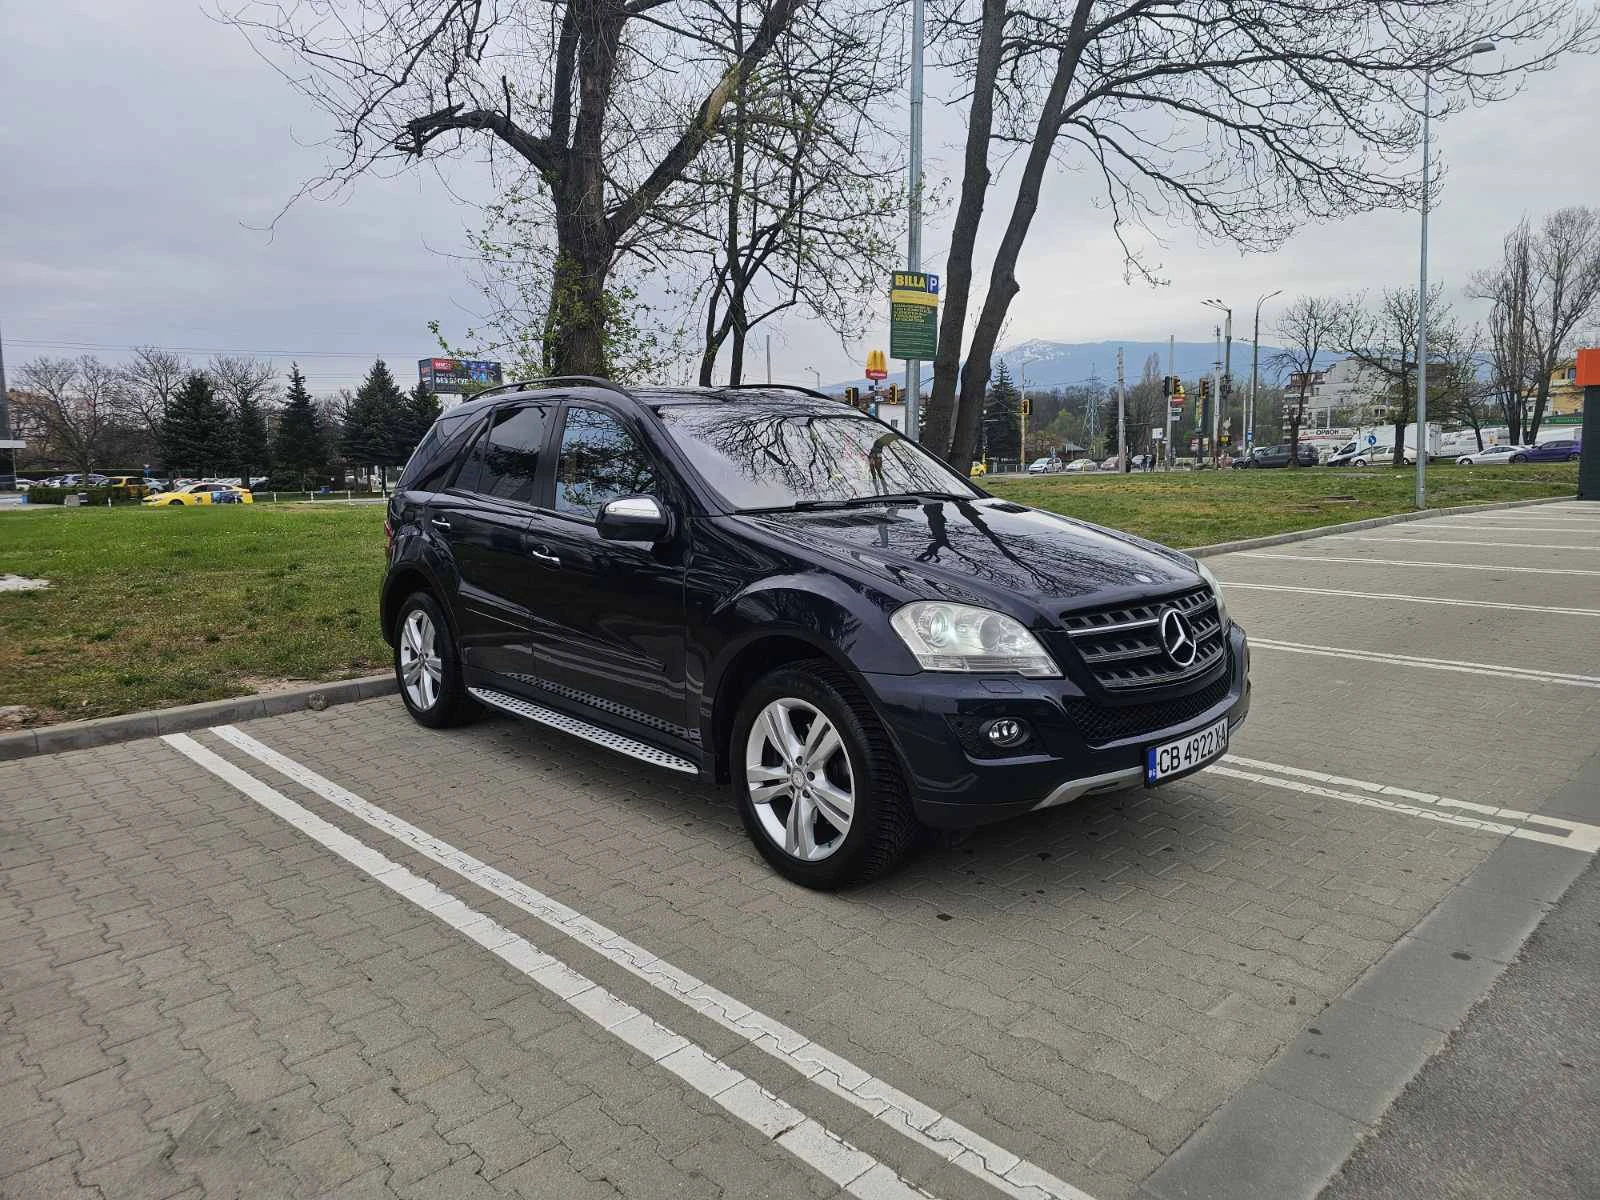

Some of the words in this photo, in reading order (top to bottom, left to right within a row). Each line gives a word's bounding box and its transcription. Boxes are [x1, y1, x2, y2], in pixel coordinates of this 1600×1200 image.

[895, 274, 925, 289] BILLA
[929, 277, 938, 291] P
[1159, 746, 1181, 774] CB
[1184, 732, 1214, 765] 4922
[1214, 723, 1226, 751] XA
